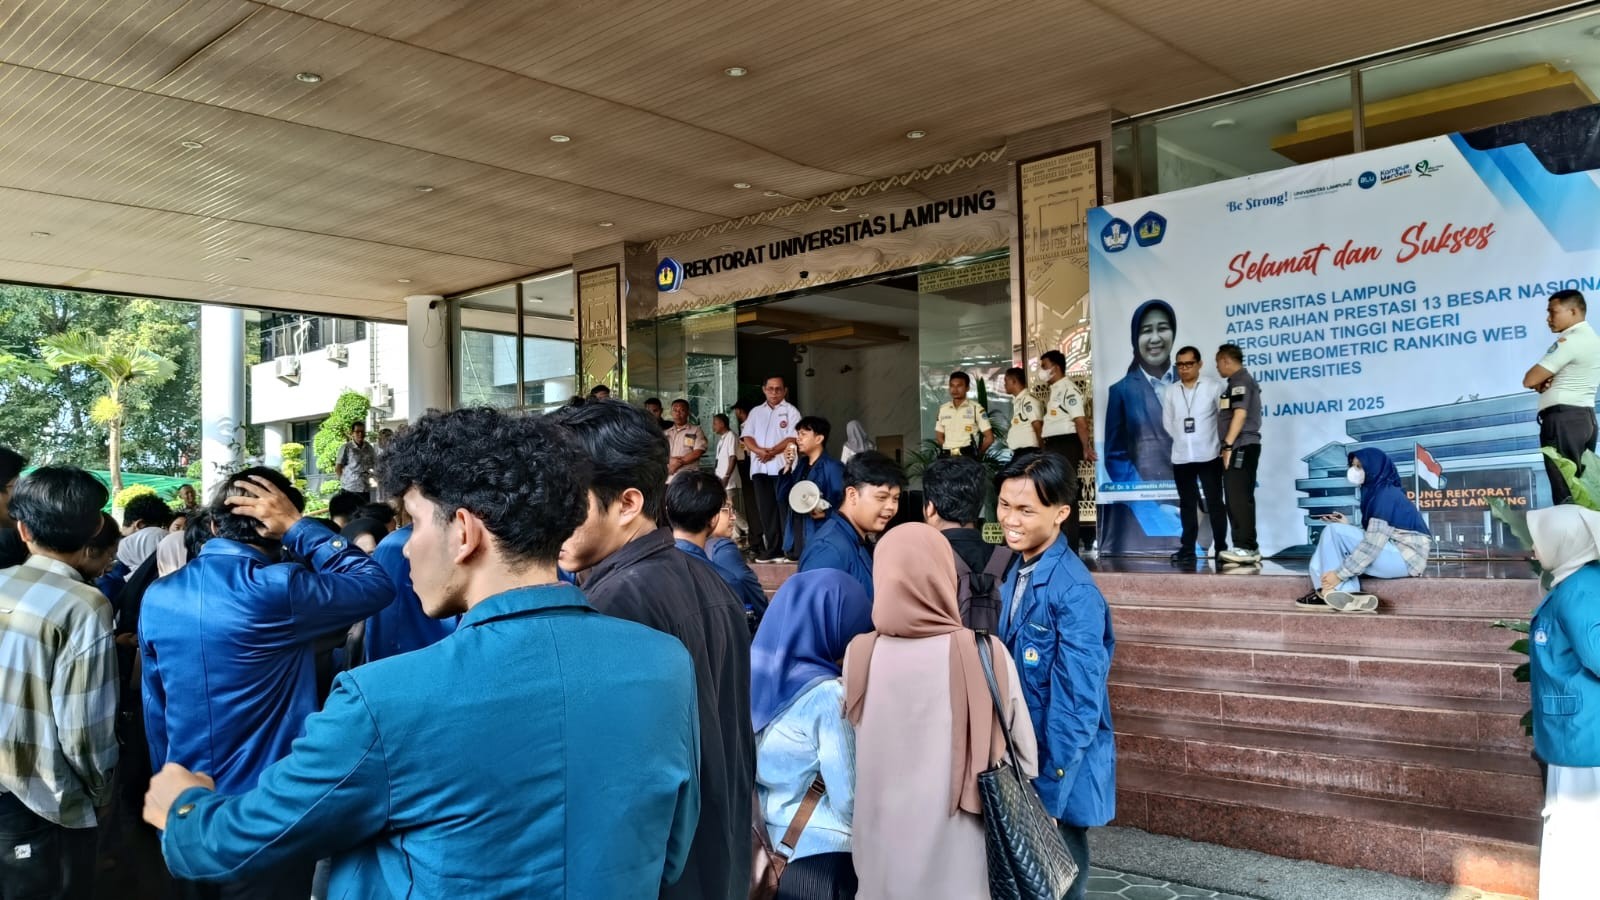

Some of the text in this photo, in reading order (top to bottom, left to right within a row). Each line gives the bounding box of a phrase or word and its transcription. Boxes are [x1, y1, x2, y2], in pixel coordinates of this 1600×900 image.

[1360, 175, 1375, 184] BLU
[1381, 164, 1409, 175] Kampus
[1381, 169, 1412, 181] Merdeka
[1226, 201, 1242, 212] Be
[1245, 191, 1287, 210] Strong!
[683, 190, 996, 279] REKTORAT UNIVERSITAS LAMPUNG
[1225, 221, 1495, 288] Selamat dan Sukses
[1226, 280, 1416, 317] UNIVERSITAS LAMPUNG
[1226, 319, 1264, 334] ATAS
[1269, 310, 1328, 329] RAIHAN
[1334, 299, 1416, 321] PRESTASI
[1422, 296, 1441, 311] 13
[1447, 287, 1511, 307] BESAR
[1330, 322, 1386, 340] TINGGI
[1392, 313, 1459, 333] NEGERI
[1277, 340, 1387, 363] WEBOMETRIC
[1394, 330, 1476, 351] RANKING
[1483, 325, 1527, 342] WEB
[1253, 361, 1362, 383] UNIVERSITIES
[1273, 399, 1342, 416] JANUARI
[1348, 396, 1385, 412] 2025
[1411, 496, 1526, 508] RSITAS LAMNG
[1446, 487, 1511, 498] REKTORAT
